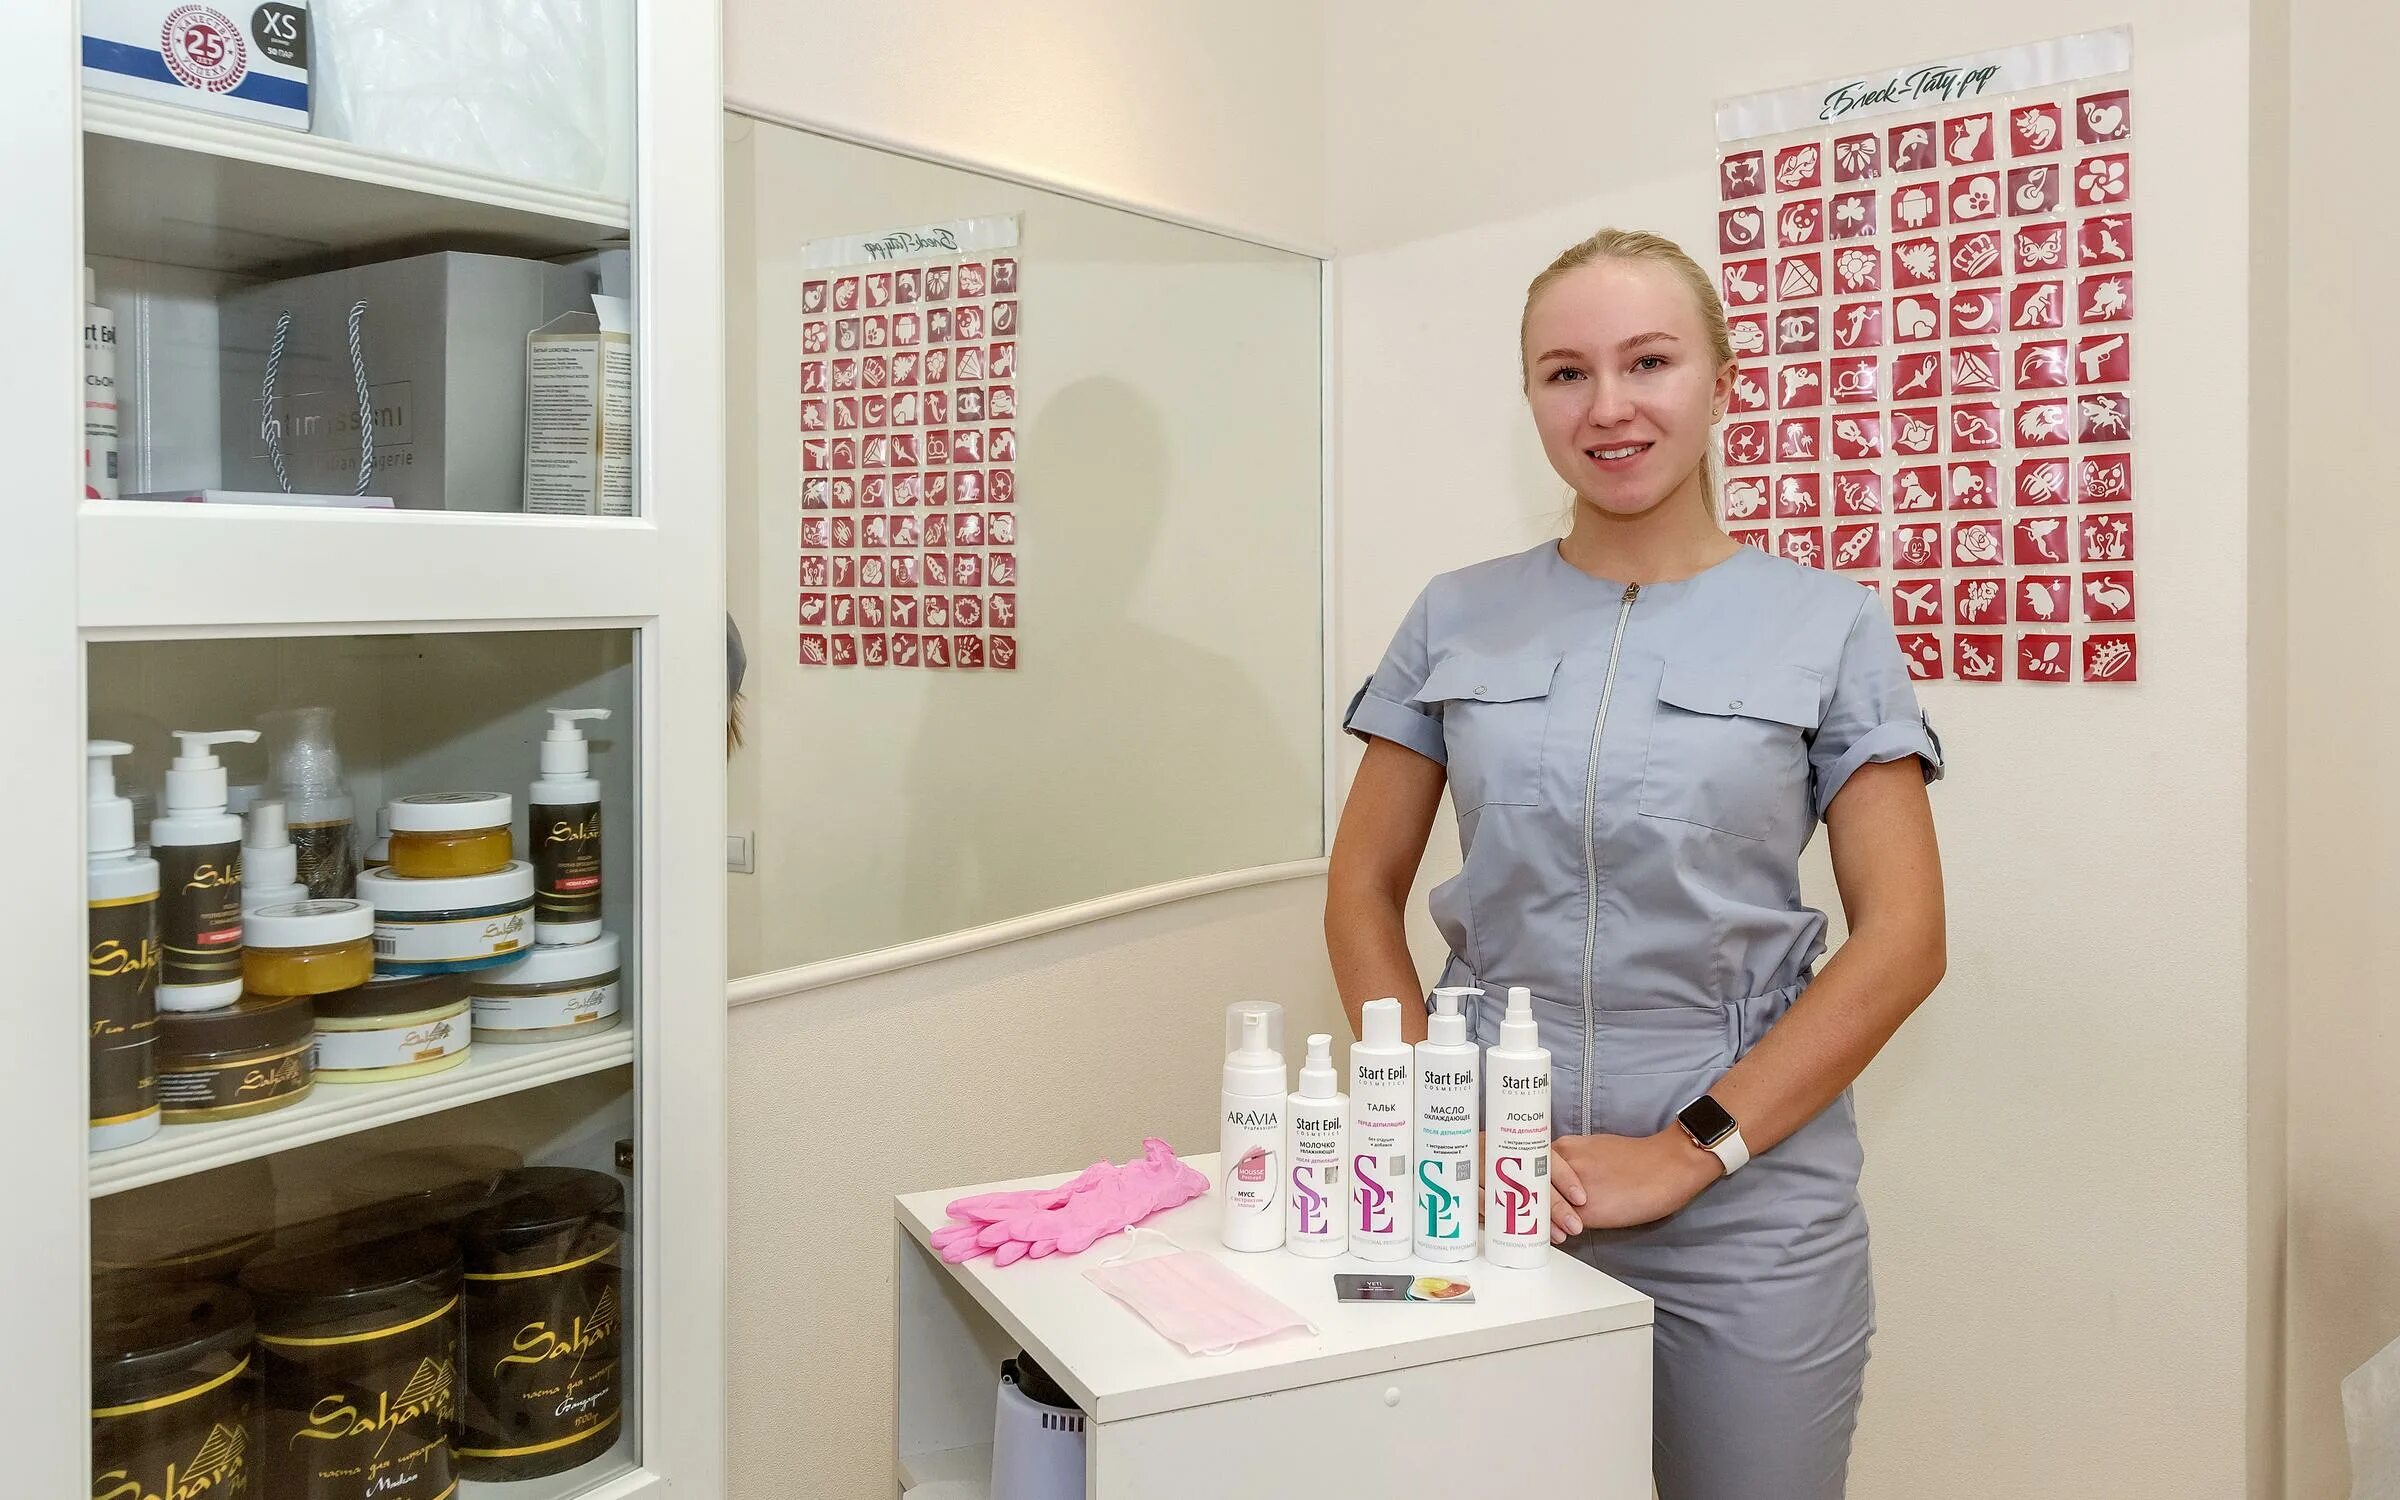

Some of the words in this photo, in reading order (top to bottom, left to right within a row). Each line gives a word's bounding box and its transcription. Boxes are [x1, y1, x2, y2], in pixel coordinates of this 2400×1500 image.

[263, 8, 297, 40] XS
[187, 29, 223, 60] 25
[1359, 1065, 1384, 1080] Start
[1425, 1070, 1451, 1085] Start
[1359, 1079, 1405, 1087] COSMETICS
[1424, 1083, 1471, 1092] COSMETICS
[1502, 1075, 1530, 1089] Start
[1367, 1103, 1396, 1112] ТАЛЬК
[1430, 1105, 1465, 1115] МАСЛО
[1227, 1110, 1278, 1126] ARAVIA
[1423, 1113, 1471, 1122] ОХЛАЖДАЮЩЕЕ
[1507, 1111, 1544, 1122] ЛОСЬОН
[1296, 1117, 1320, 1131] Start
[1300, 1141, 1336, 1149] МОЛОЧКО
[290, 1388, 450, 1460] Sahara
